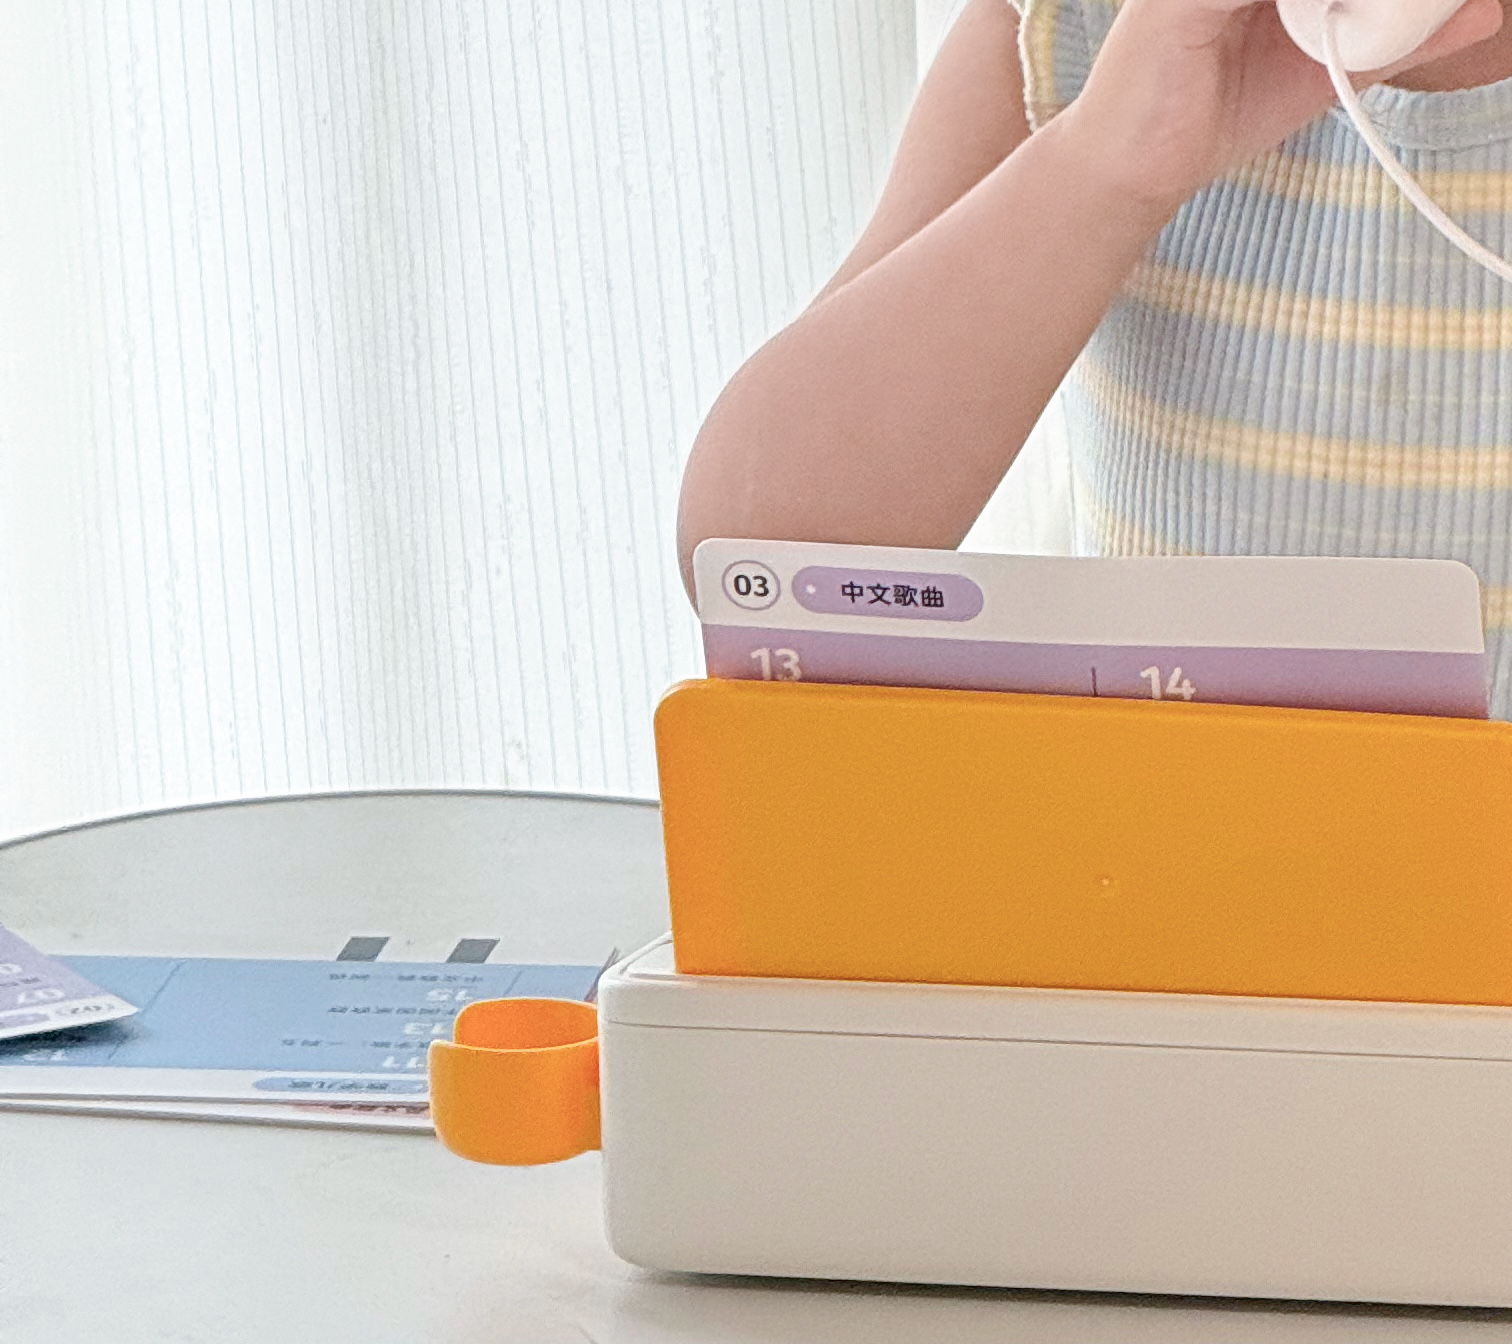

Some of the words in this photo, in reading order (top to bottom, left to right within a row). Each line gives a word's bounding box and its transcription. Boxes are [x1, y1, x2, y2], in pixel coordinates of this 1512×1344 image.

[733, 573, 770, 599] 03
[840, 580, 945, 610] 中文歌曲
[750, 646, 802, 682] 13
[1139, 665, 1197, 701] 14
